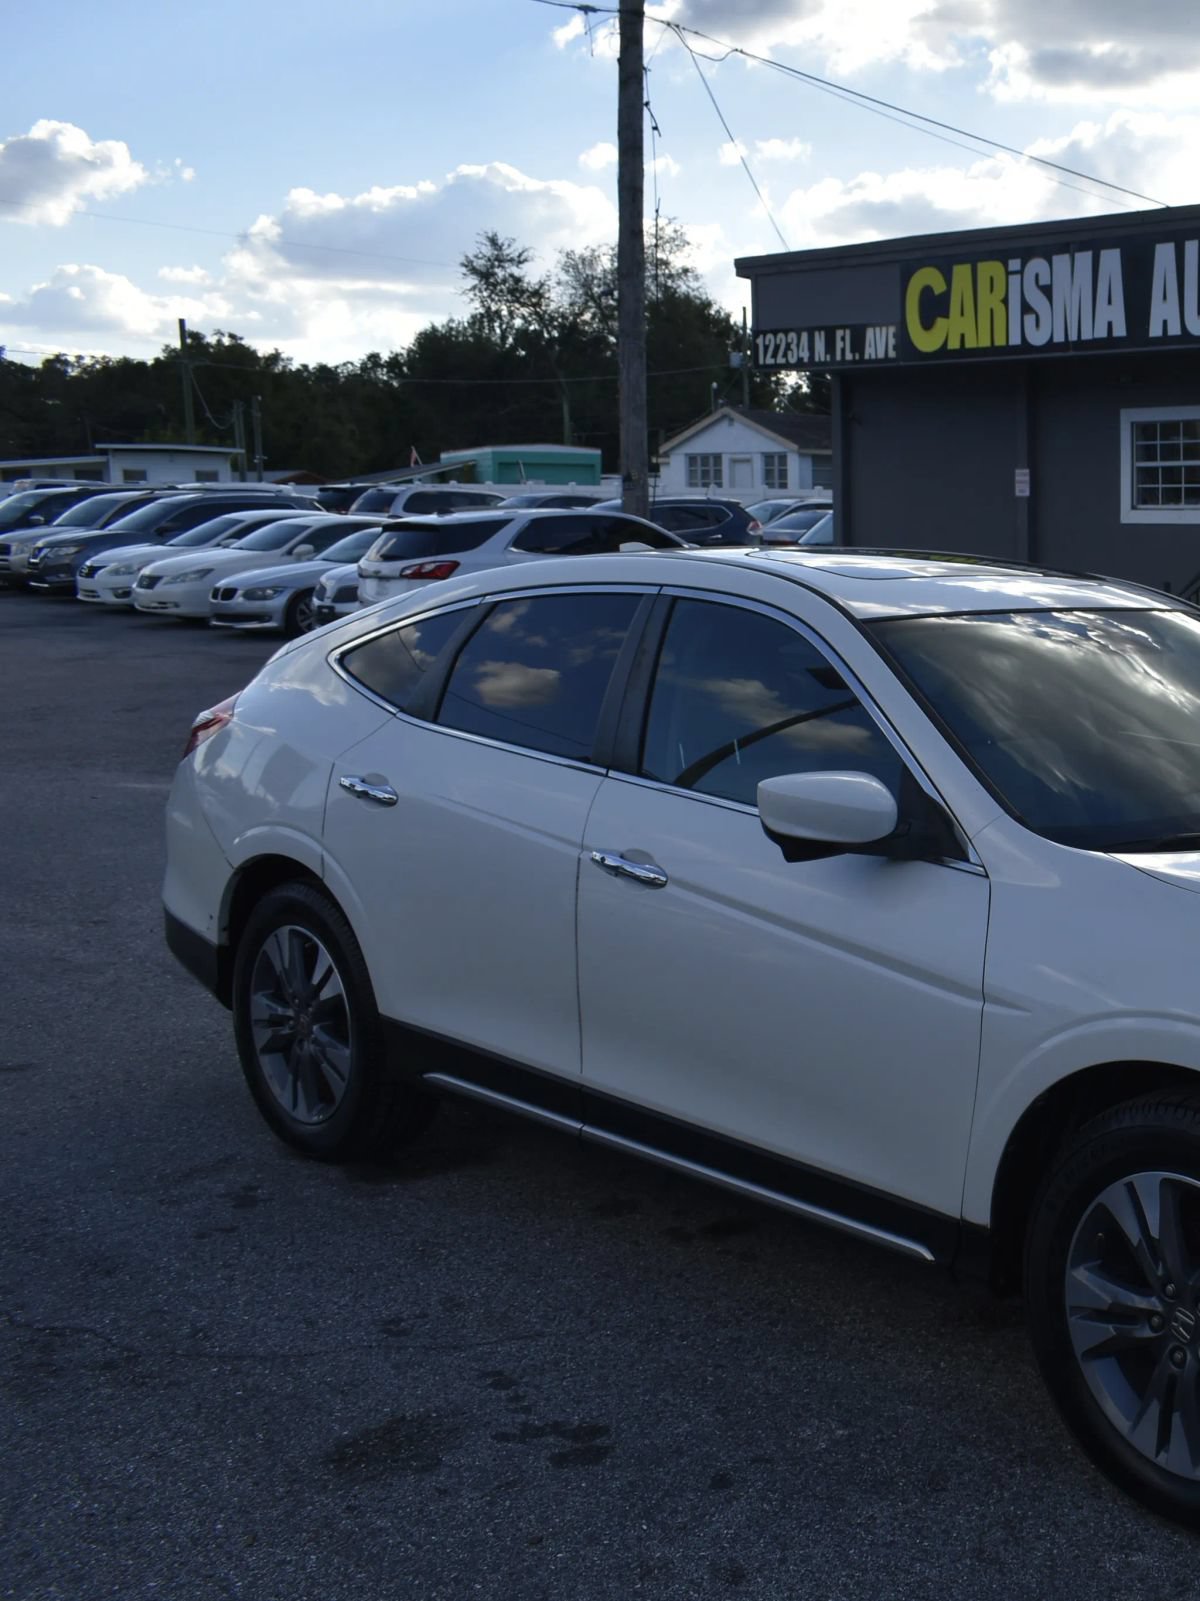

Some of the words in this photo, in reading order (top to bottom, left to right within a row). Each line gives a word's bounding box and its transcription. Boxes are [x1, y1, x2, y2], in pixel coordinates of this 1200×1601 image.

[755, 331, 810, 365] 12234
[814, 330, 831, 362] N.
[835, 328, 860, 361] FL.
[864, 326, 897, 360] AVE
